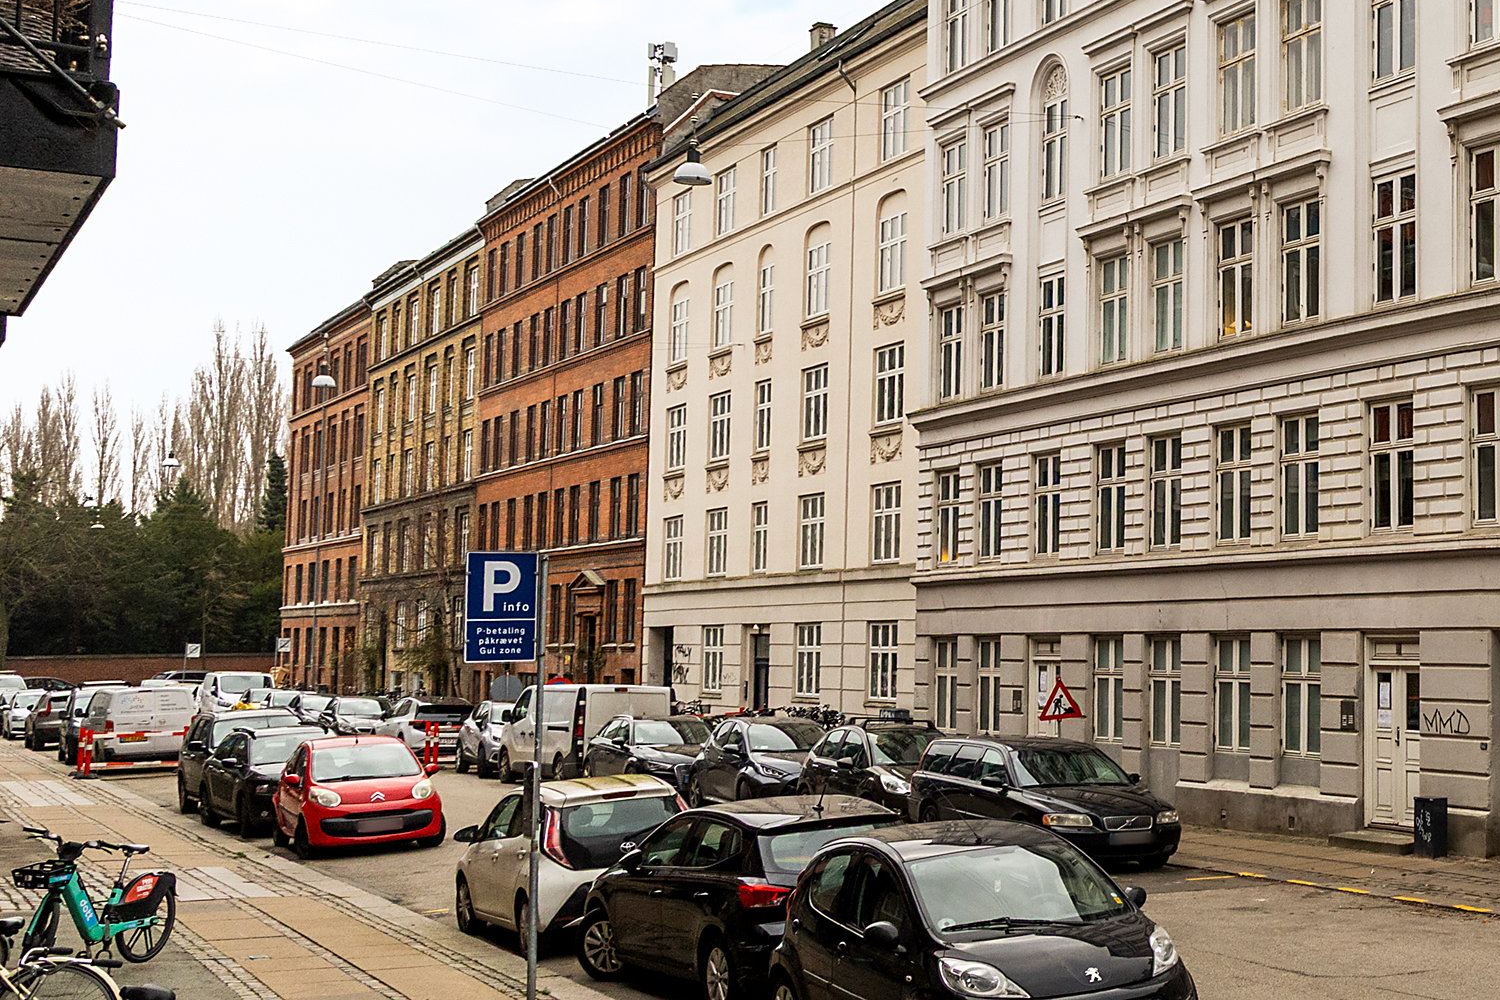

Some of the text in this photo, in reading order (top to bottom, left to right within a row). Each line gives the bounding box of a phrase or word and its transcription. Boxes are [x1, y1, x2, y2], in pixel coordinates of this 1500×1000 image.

[483, 560, 530, 612] P info
[476, 626, 526, 636] P-betaling
[478, 636, 523, 647] påkrævet
[479, 646, 496, 655] Gul
[1422, 708, 1471, 735] MMD
[79, 899, 94, 922] dott
